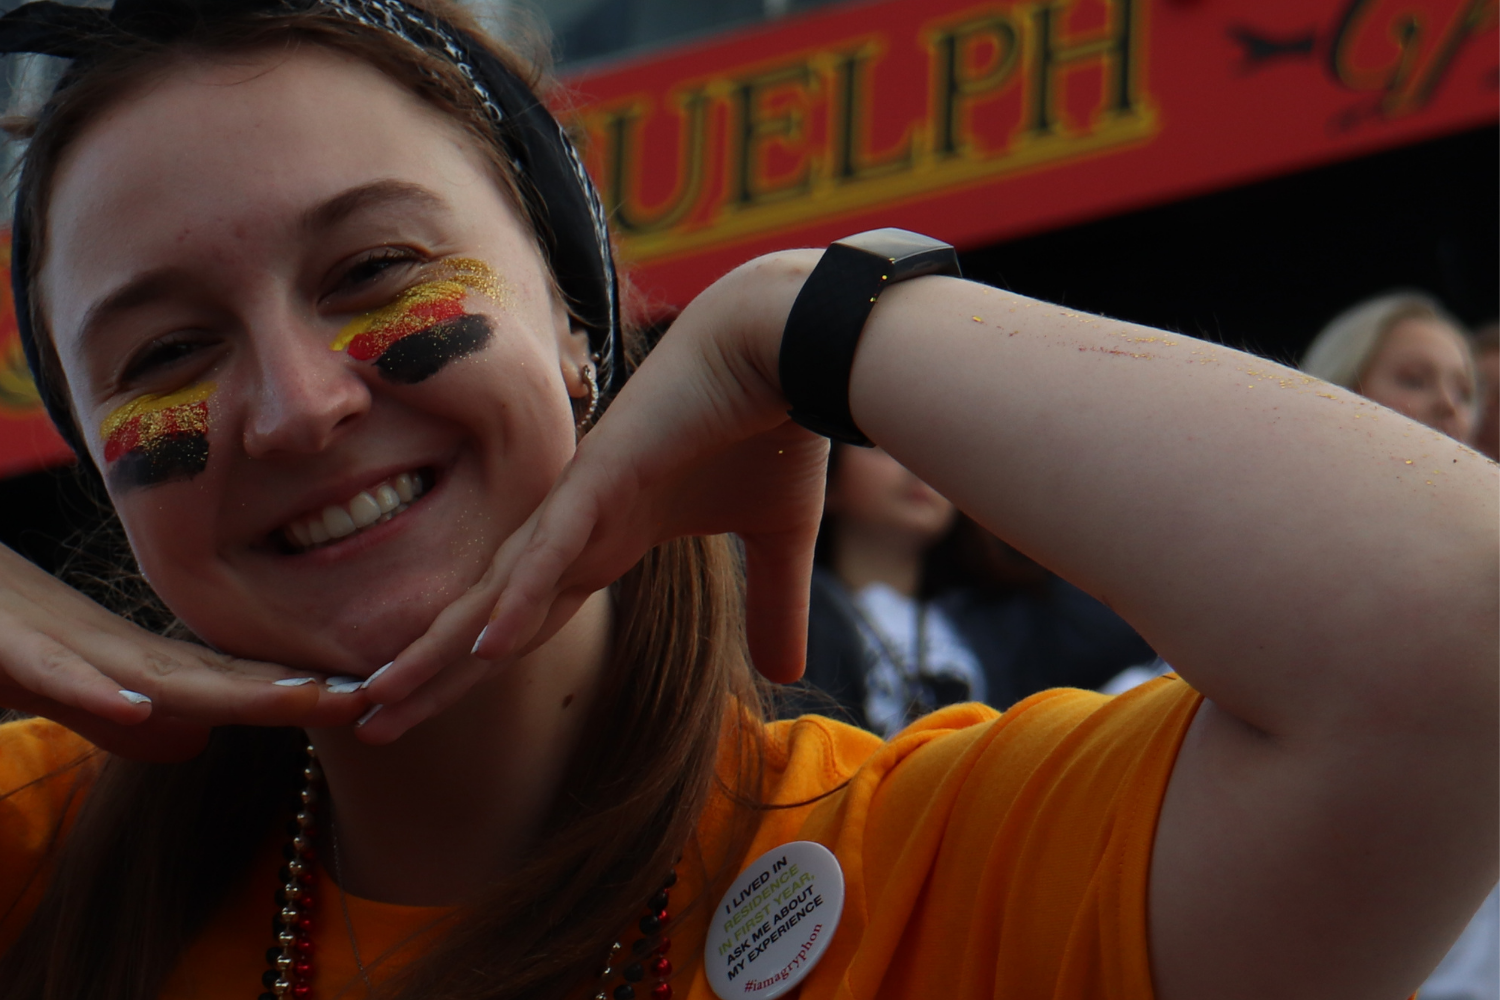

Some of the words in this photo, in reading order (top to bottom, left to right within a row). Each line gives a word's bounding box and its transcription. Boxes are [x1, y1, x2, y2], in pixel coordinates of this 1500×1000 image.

[566, 0, 1154, 240] UELPH
[724, 863, 799, 933] RESIDENCE
[725, 904, 731, 914] I
[732, 871, 770, 908] LIVED
[772, 855, 787, 874] IN
[718, 938, 733, 956] IN
[734, 903, 771, 941] FIRST
[727, 938, 751, 966] ASK
[751, 920, 771, 942] ME
[774, 884, 813, 925] ABOUT
[727, 958, 745, 981] MY
[747, 894, 824, 962] EXPERIENCE
[744, 923, 822, 993] #iamagryphon
